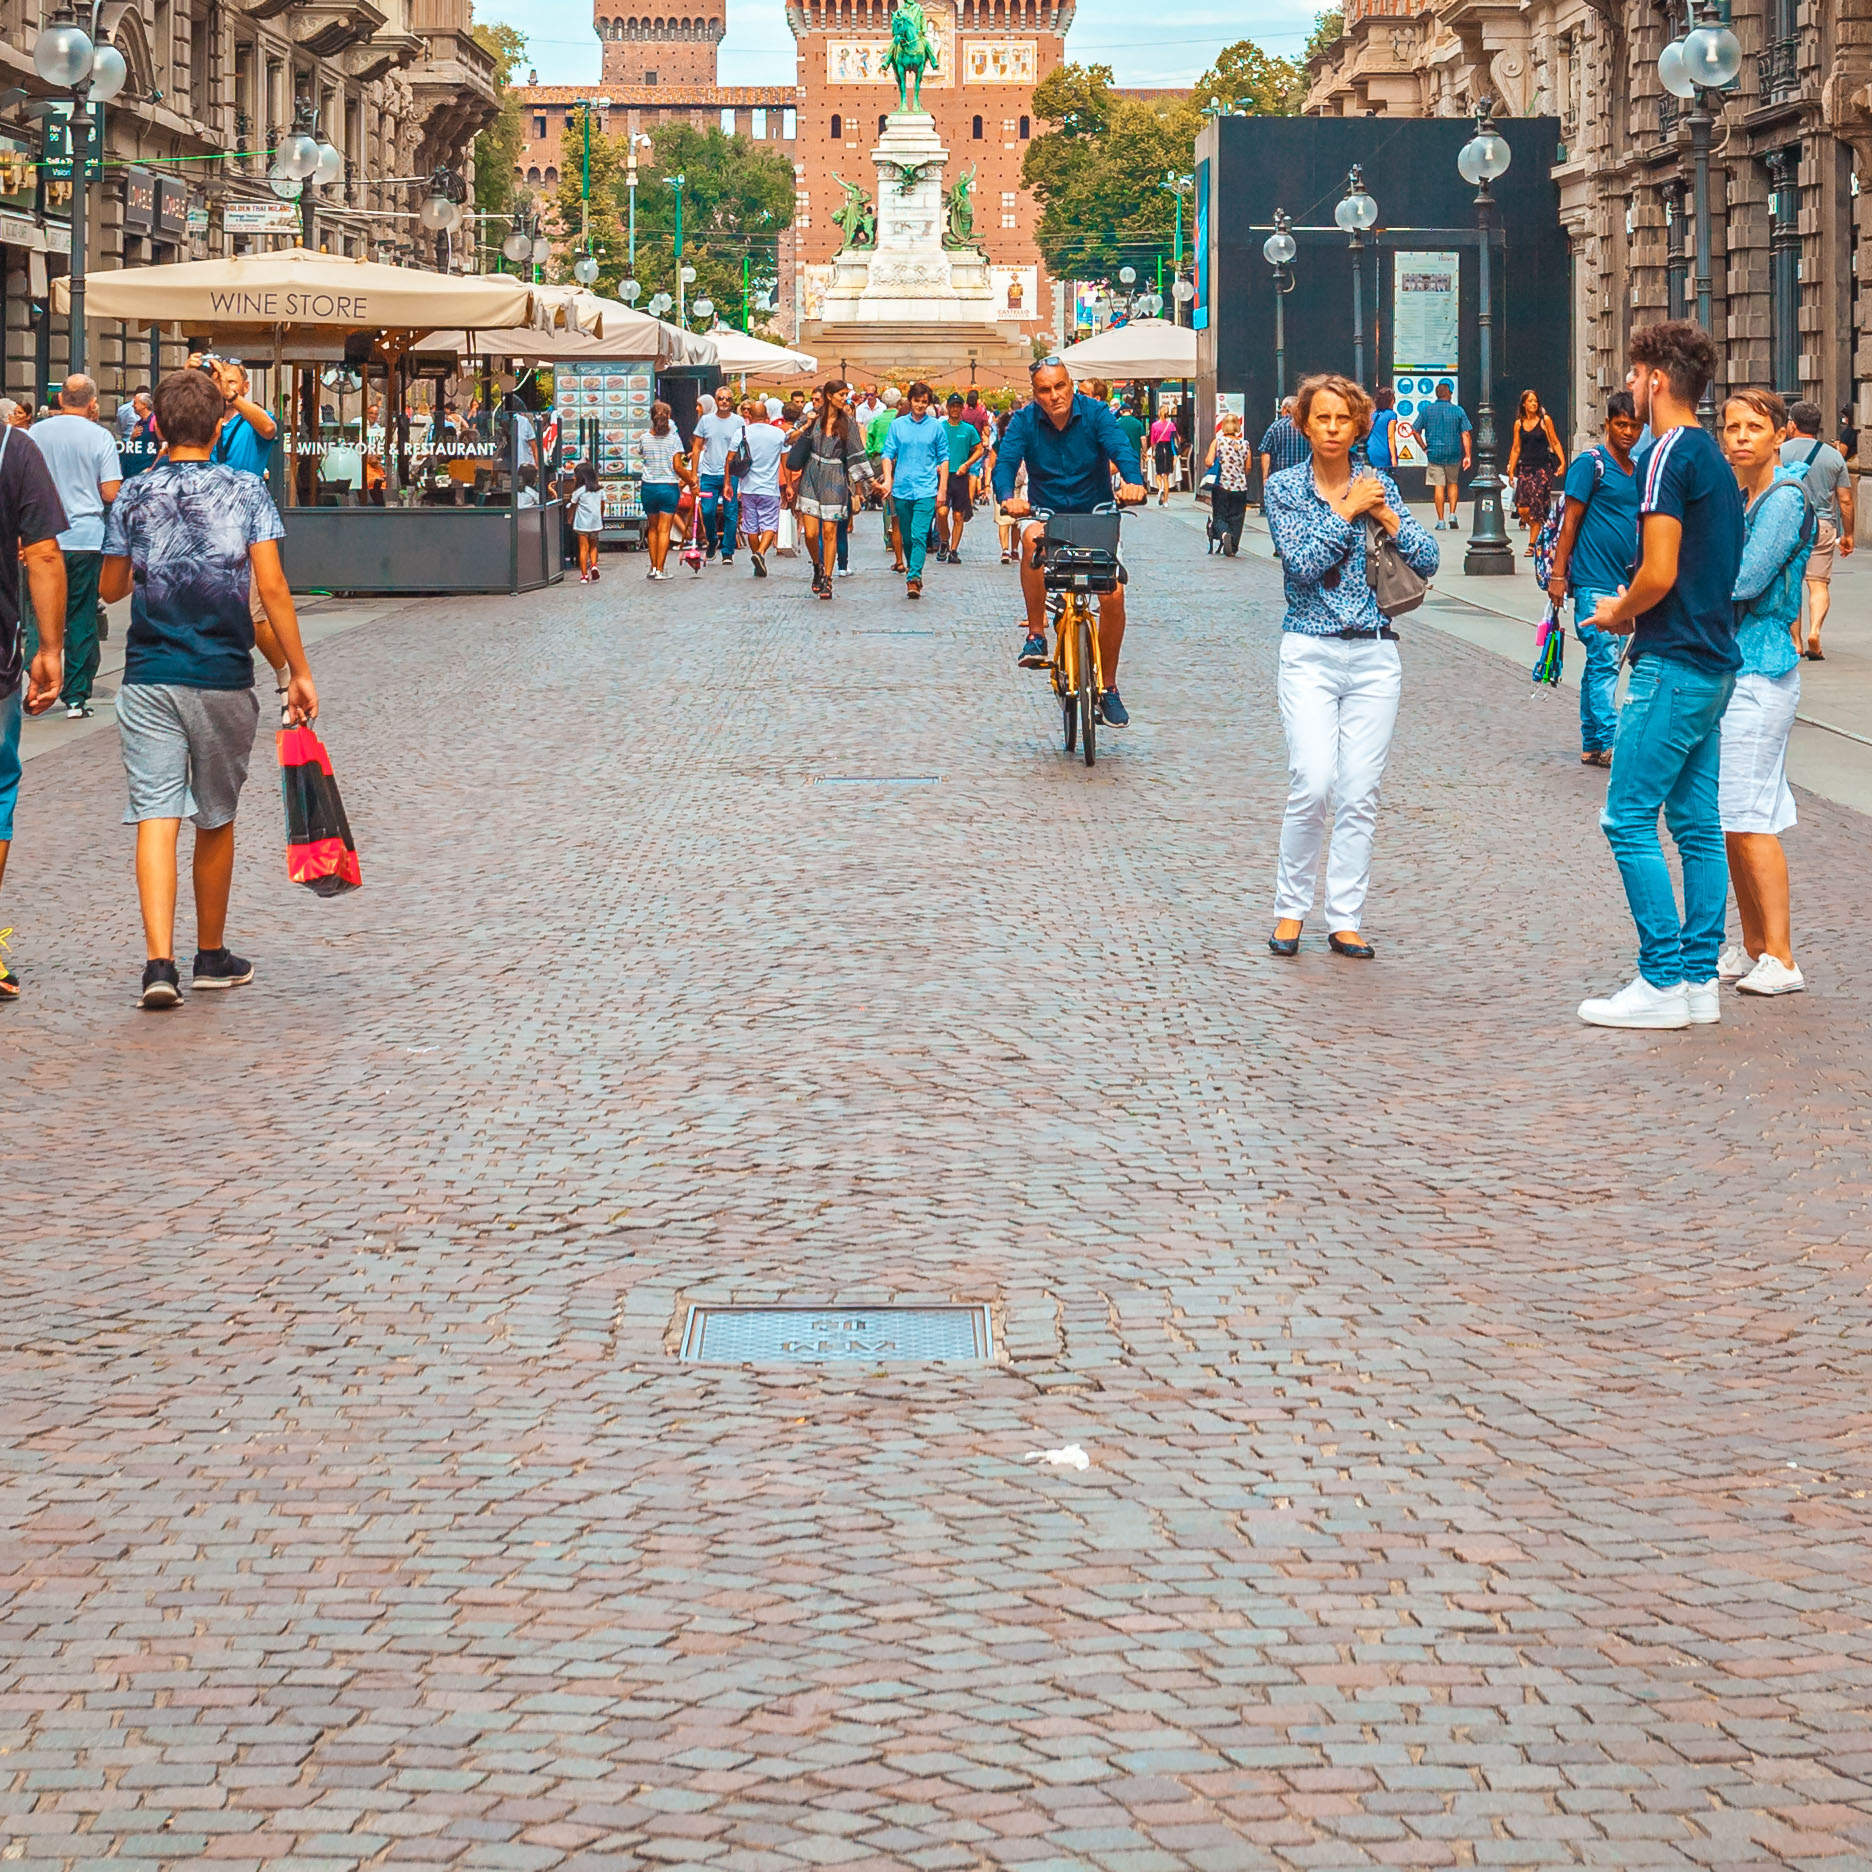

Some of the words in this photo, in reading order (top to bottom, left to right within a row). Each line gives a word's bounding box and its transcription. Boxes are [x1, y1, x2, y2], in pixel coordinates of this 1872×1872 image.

[211, 292, 277, 315] WINE
[286, 293, 367, 319] STORE
[146, 441, 157, 455] &
[404, 442, 496, 457] RESTAURANT
